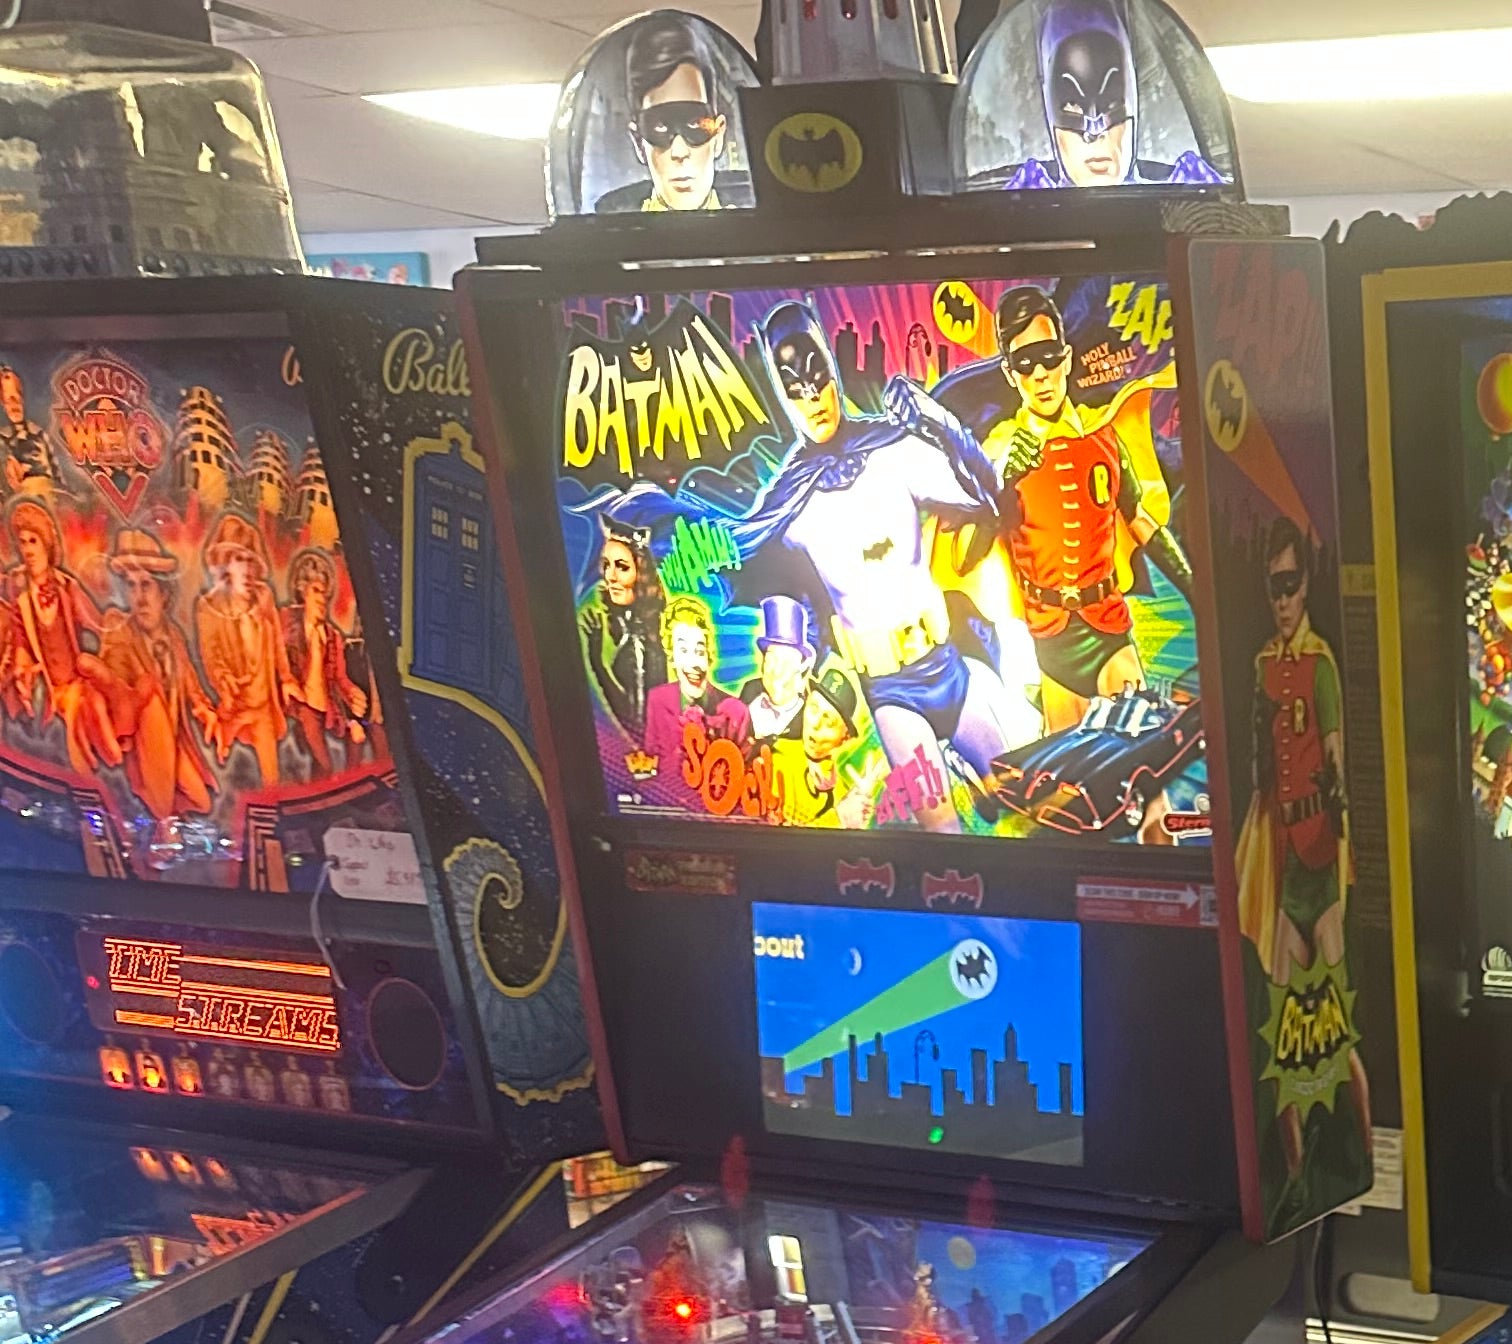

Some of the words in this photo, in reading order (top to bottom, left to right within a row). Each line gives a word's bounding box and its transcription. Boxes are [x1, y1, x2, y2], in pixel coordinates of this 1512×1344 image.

[1080, 341, 1110, 368] HOLY
[1088, 346, 1138, 374] PINBALL
[63, 365, 145, 405] DOCTOR
[563, 314, 770, 479] BATMAN
[53, 408, 165, 471] WHO
[104, 944, 183, 984] TIME
[174, 994, 340, 1045] STREAMS
[1276, 983, 1349, 1064] BATMAN
